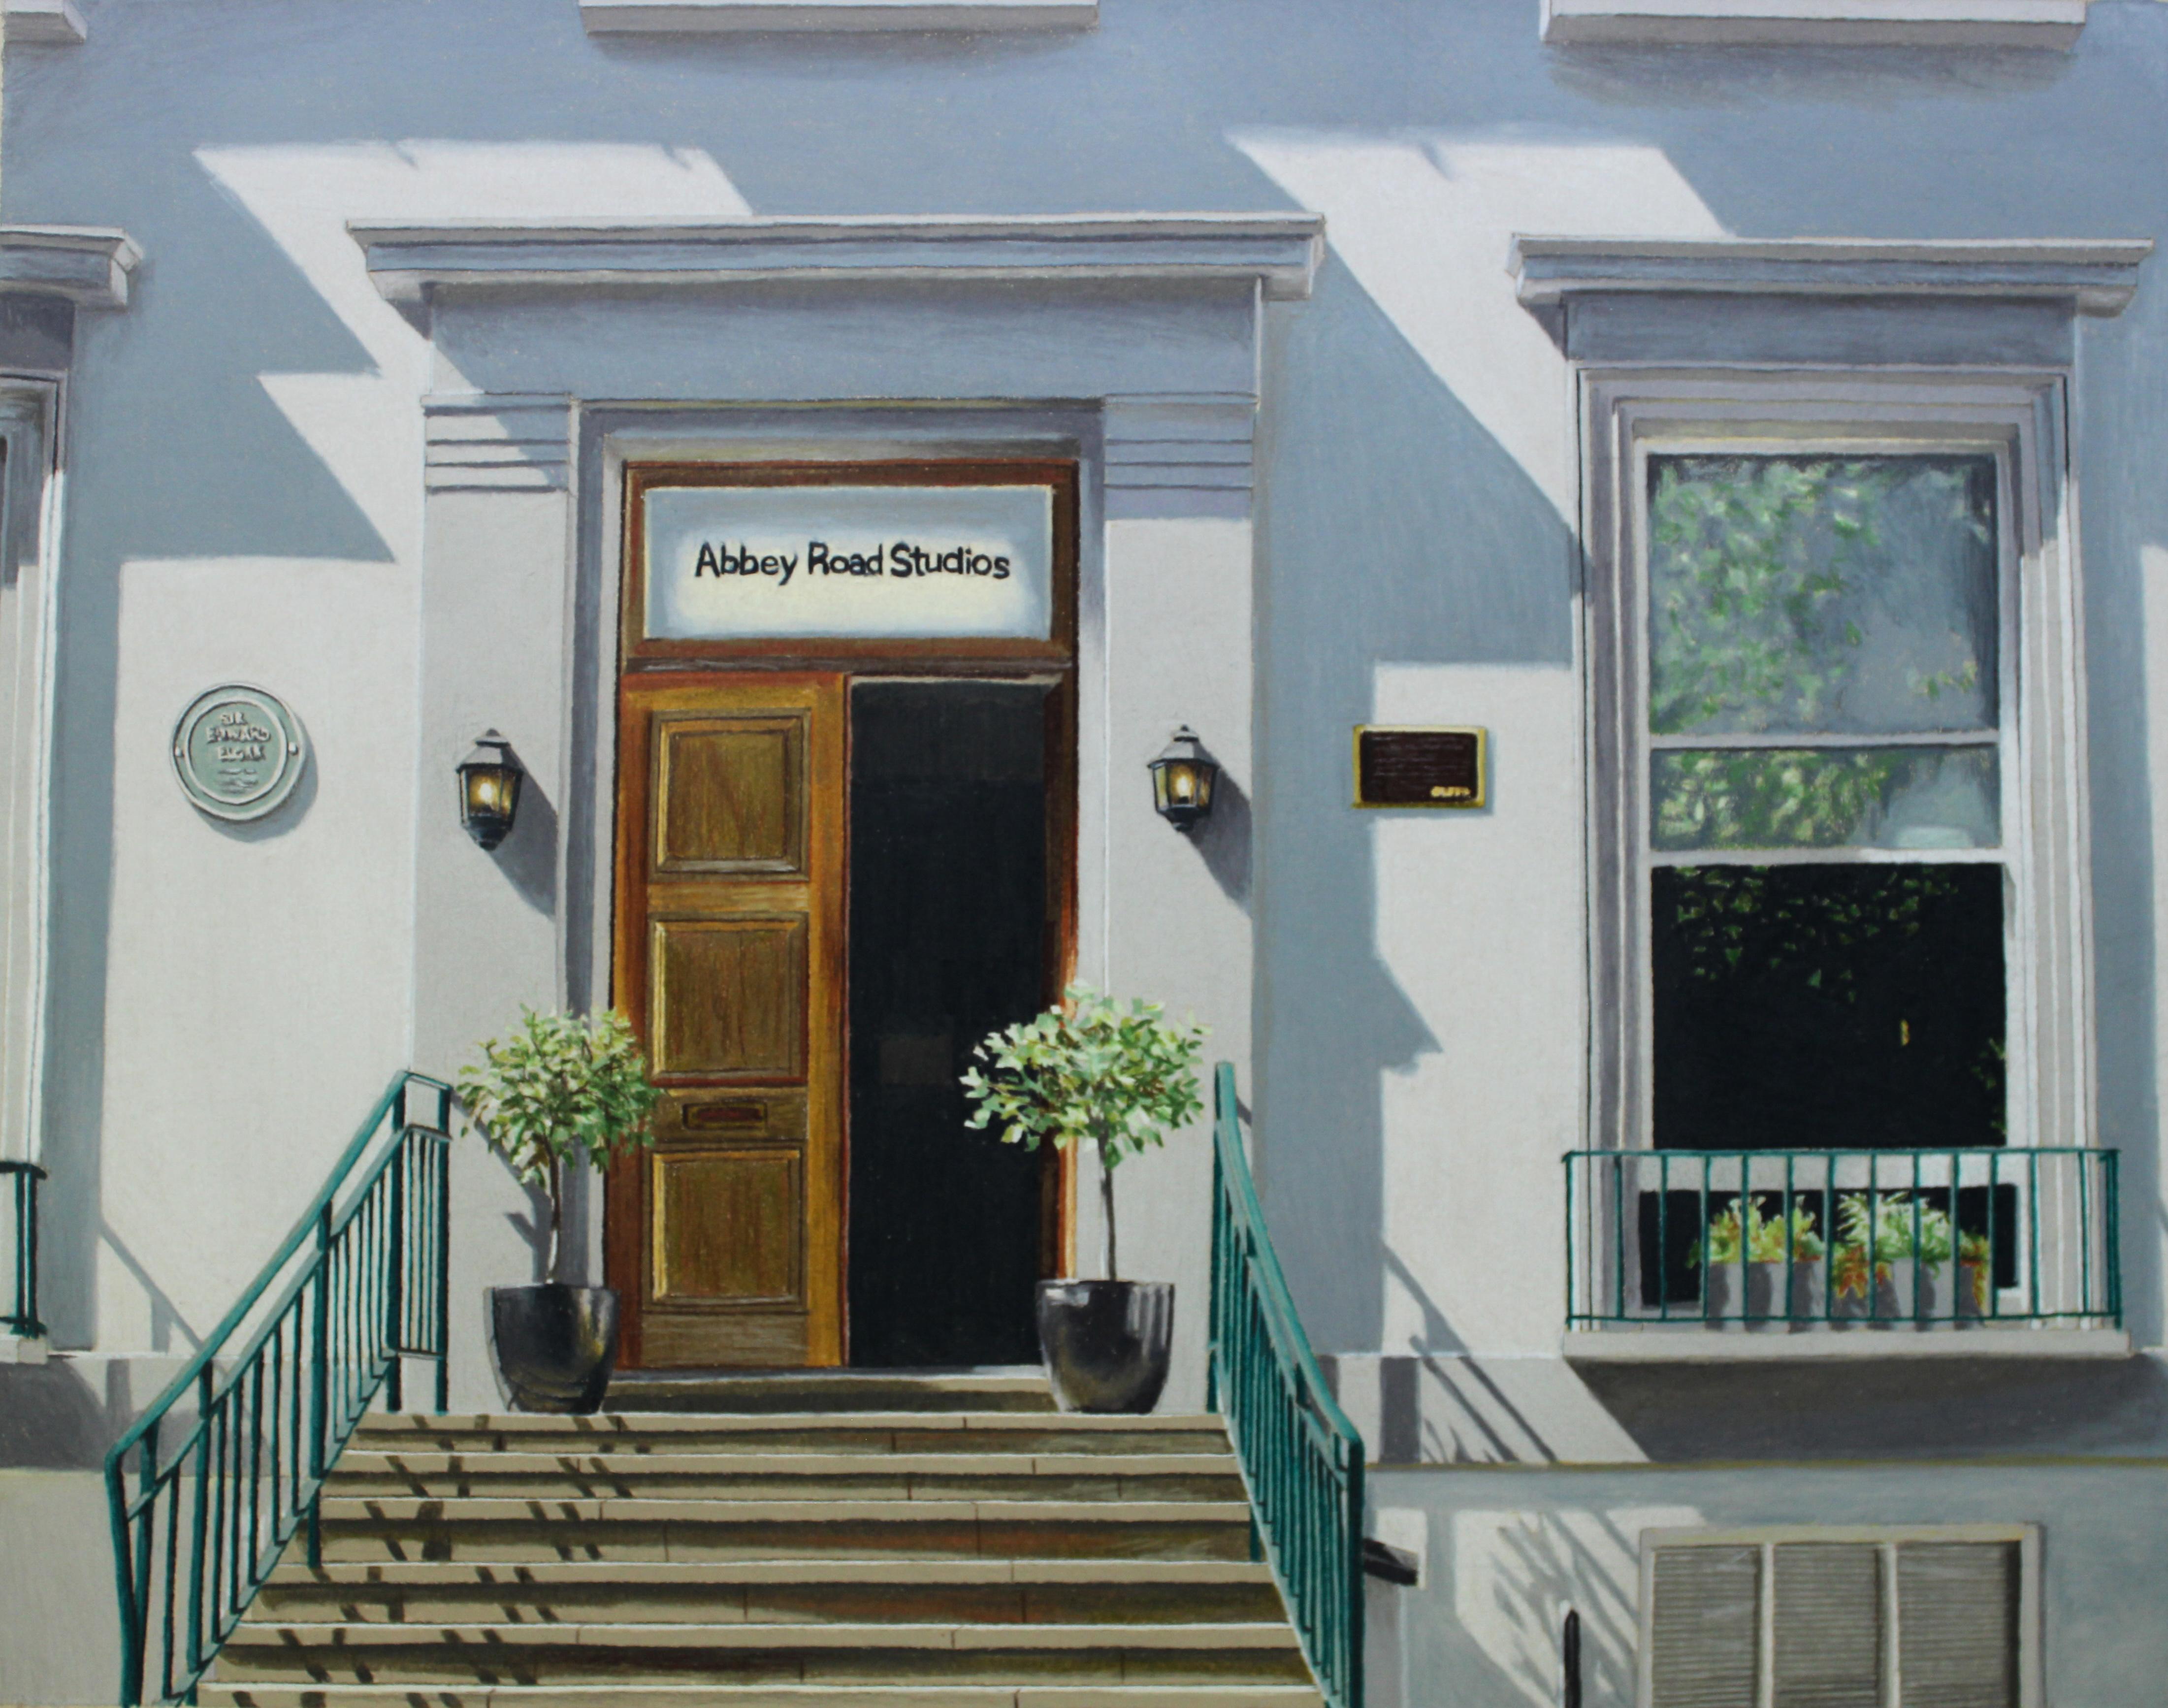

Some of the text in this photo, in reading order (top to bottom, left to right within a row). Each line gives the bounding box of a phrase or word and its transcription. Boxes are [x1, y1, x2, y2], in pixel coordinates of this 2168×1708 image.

[694, 541, 1010, 585] Abbey Road Studios
